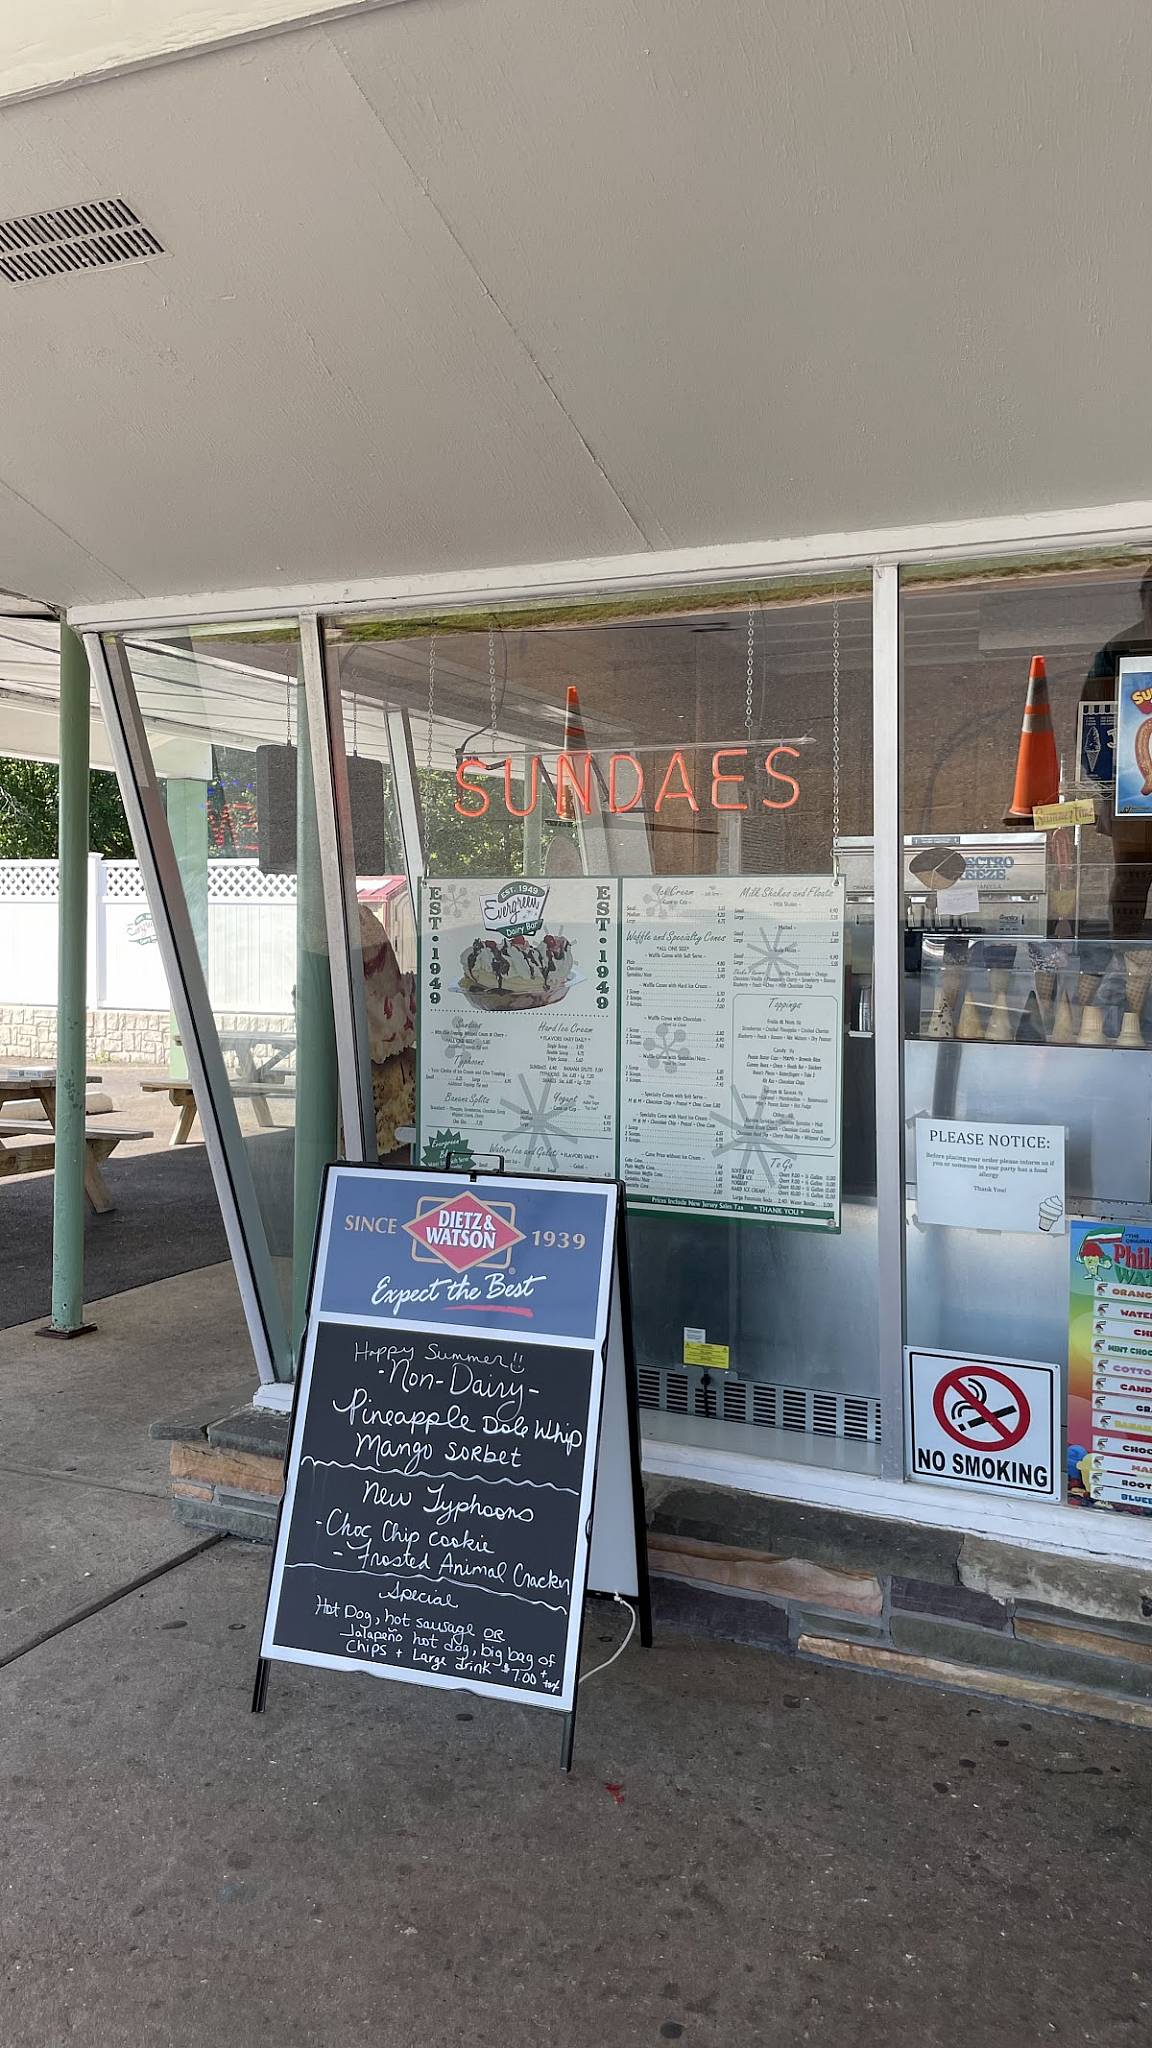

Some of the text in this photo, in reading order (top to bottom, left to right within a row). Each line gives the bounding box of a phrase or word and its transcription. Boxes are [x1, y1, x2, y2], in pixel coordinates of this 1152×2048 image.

[454, 746, 801, 817] SUNDAES
[965, 856, 1014, 868] ECTRO
[960, 869, 1006, 880] EEZE
[518, 884, 539, 895] 1949
[484, 895, 540, 924] Evergreen
[626, 930, 727, 945] Waffle and Specialty Cones
[769, 997, 803, 1012] Toppings
[538, 1021, 593, 1033] Hard Ice Cream
[553, 1092, 578, 1105] Yogurt
[930, 1129, 1051, 1149] PLEASE NOTICE:
[781, 1159, 793, 1171] Go
[926, 1152, 944, 1160] Before
[946, 1153, 967, 1162] placing
[999, 1157, 1019, 1166] please
[973, 1185, 992, 1193] Thank
[668, 1198, 687, 1206] Include
[688, 1200, 701, 1208] New
[701, 1201, 719, 1210] Jersey
[719, 1202, 733, 1210] Sales
[734, 1203, 744, 1211] Tax
[758, 1206, 799, 1216] THANK YOU
[344, 1214, 397, 1234] SINCE
[438, 1209, 497, 1232] DIETZ &
[425, 1226, 497, 1250] WATSON
[531, 1230, 587, 1250] 1939
[371, 1273, 547, 1316] Expect the Best
[354, 1341, 415, 1363] Happy
[332, 1387, 583, 1455] Pineapple Dole Whip
[356, 1433, 433, 1476] Mango
[918, 1447, 1048, 1487] NO SMOKING
[363, 1480, 534, 1525] New Typhoons
[382, 1519, 420, 1545] Chip
[428, 1530, 495, 1553] Cookie
[346, 1541, 431, 1571] Frosted
[438, 1553, 508, 1583] Animal
[315, 1595, 341, 1618] Hot
[384, 1608, 411, 1628] hot
[416, 1618, 476, 1646] sausage
[483, 1627, 506, 1643] OR
[346, 1640, 388, 1657] Chips
[412, 1648, 448, 1671] Large
[455, 1656, 492, 1675] drink
[412, 1631, 439, 1648] hot
[481, 1643, 503, 1667] big
[508, 1646, 534, 1671] bag
[538, 1653, 556, 1668] of
